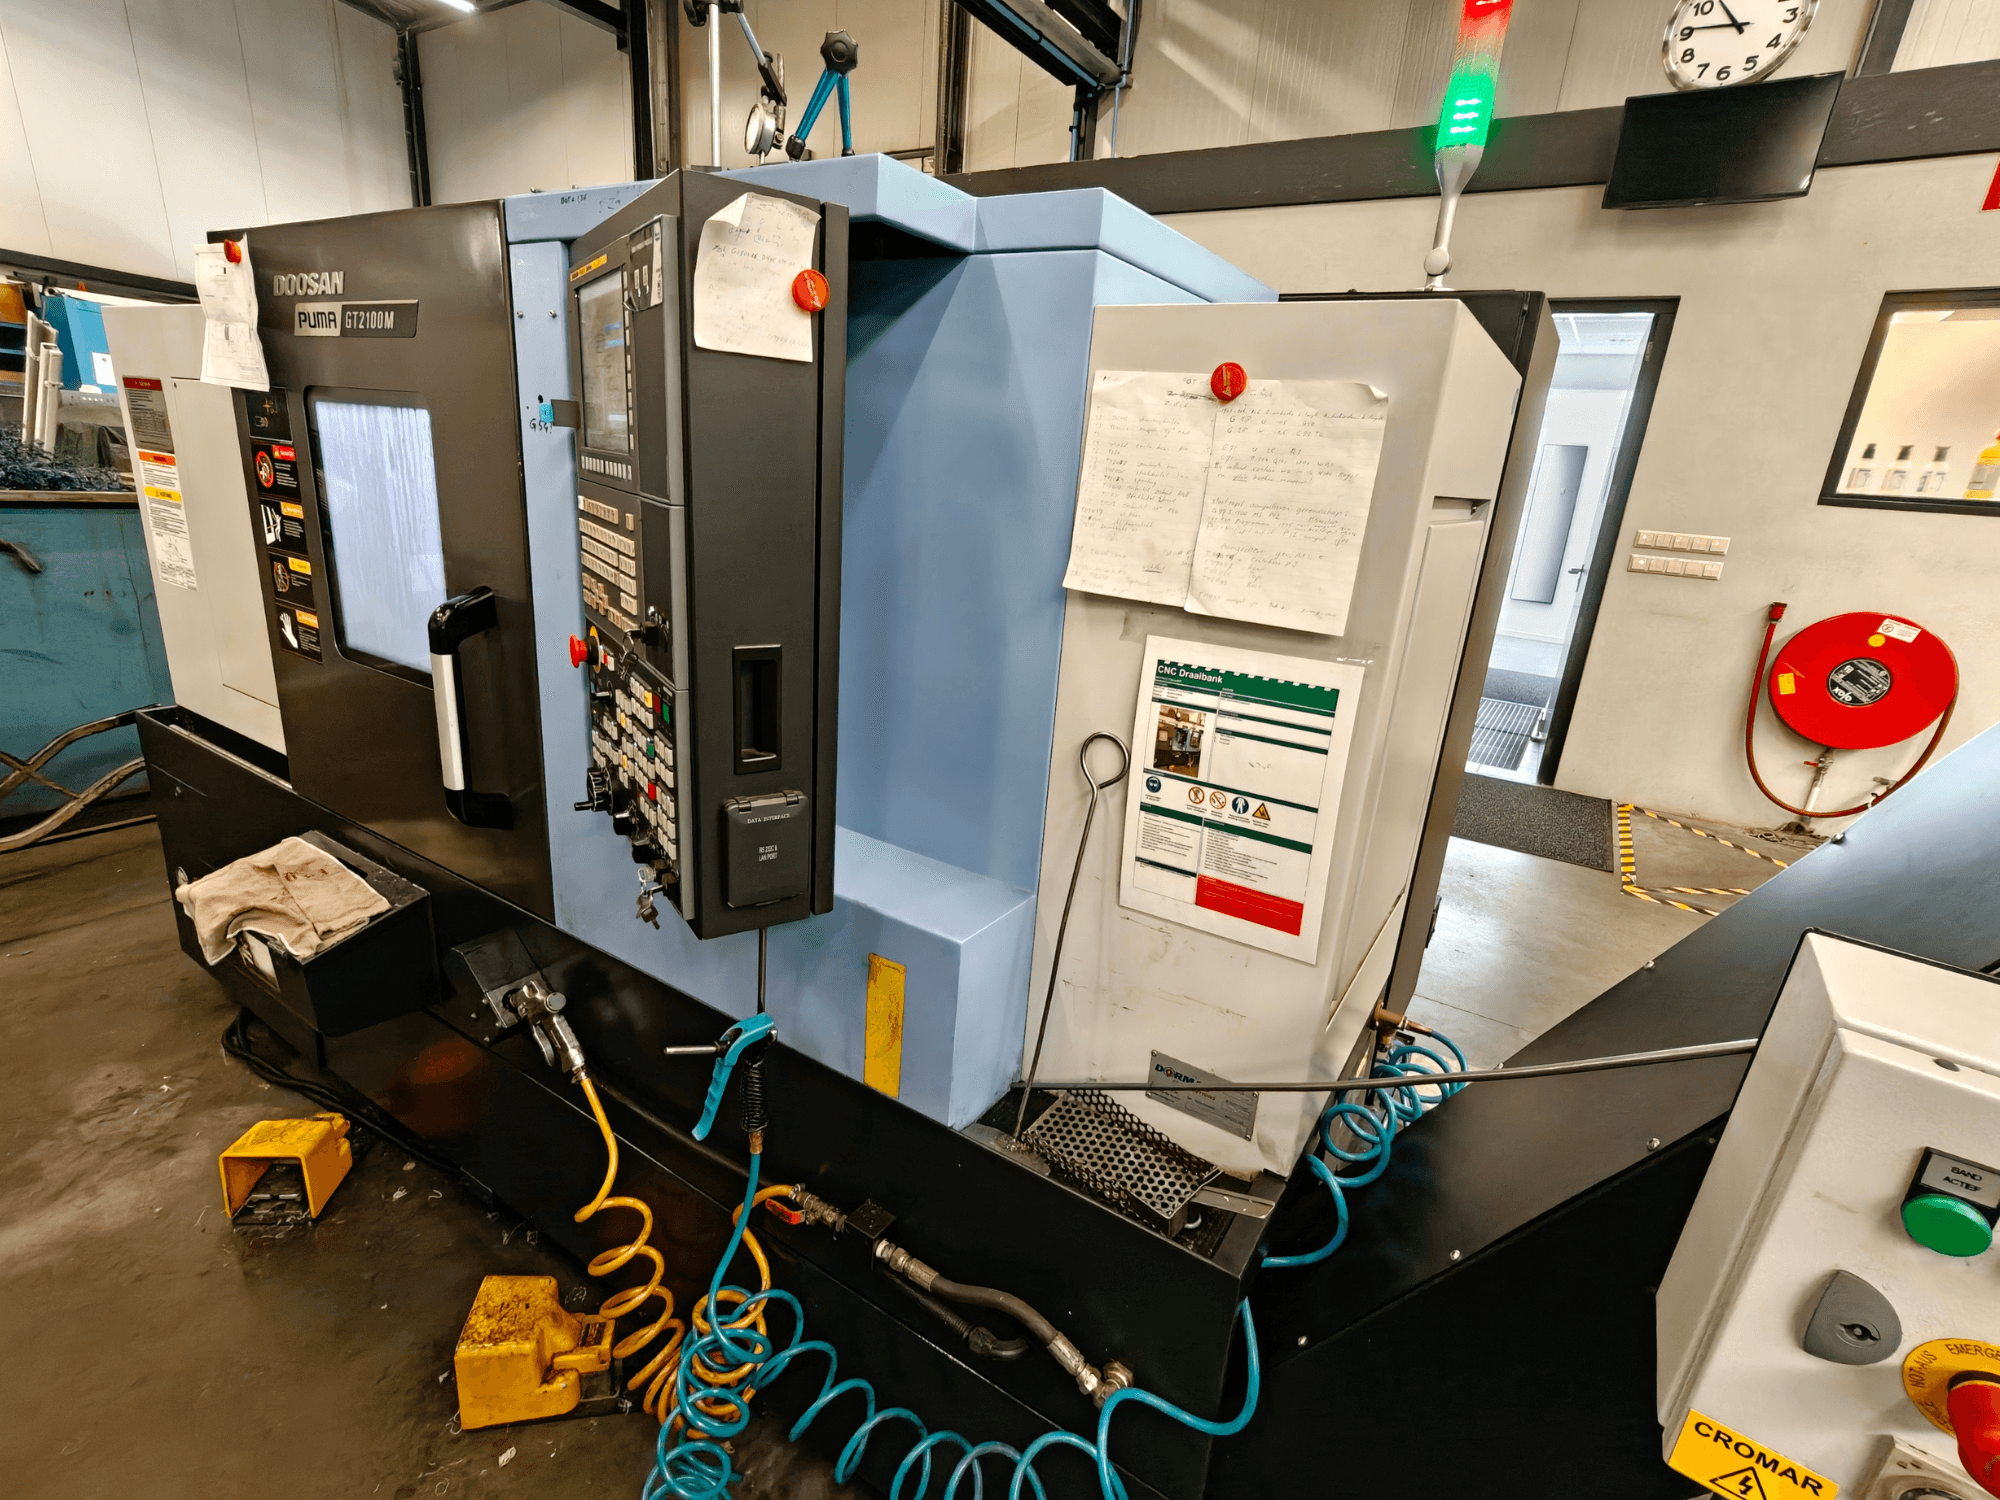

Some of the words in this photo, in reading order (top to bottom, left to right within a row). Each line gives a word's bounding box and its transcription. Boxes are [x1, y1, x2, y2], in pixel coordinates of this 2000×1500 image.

[1693, 0, 1714, 16] 10
[1782, 7, 1799, 24] 3
[1679, 26, 1694, 41] 9
[1766, 33, 1782, 49] 4
[1680, 48, 1695, 63] 8
[1742, 55, 1760, 71] 5
[1697, 62, 1710, 79] 7
[1716, 66, 1732, 81] 6
[273, 271, 344, 296] DOOSAN
[298, 312, 338, 329] PUMA
[345, 311, 394, 330] GT2100M
[1157, 665, 1178, 676] CNC
[1179, 668, 1223, 684] Draaibank
[763, 813, 790, 821] INTERFACE
[1950, 1166, 1982, 1181] BAND
[1943, 1176, 1982, 1192] ACTIEF
[1694, 1421, 1824, 1497] CROMAR
